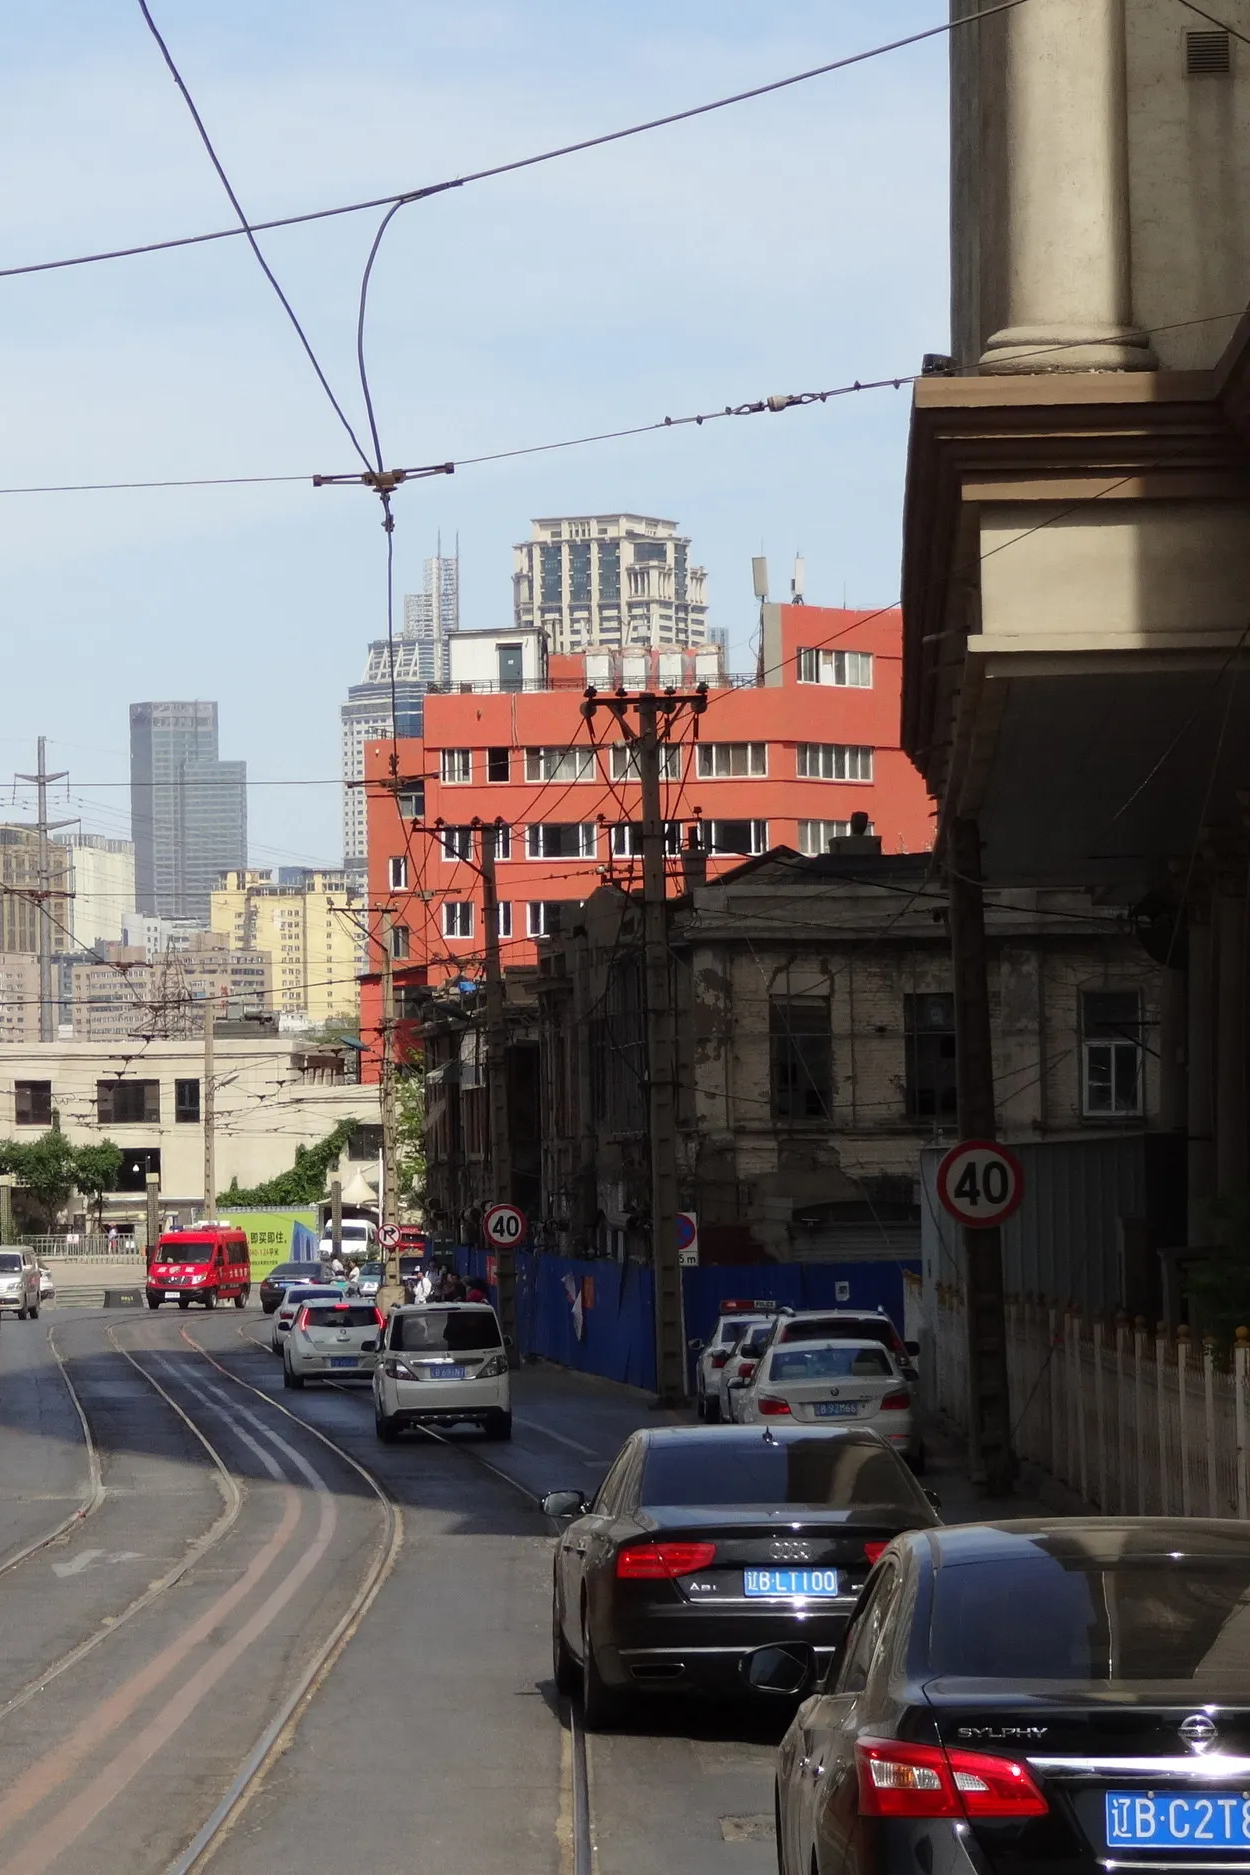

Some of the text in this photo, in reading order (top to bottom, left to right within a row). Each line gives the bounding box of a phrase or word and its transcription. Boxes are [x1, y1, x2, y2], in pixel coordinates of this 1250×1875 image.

[953, 1161, 1009, 1206] 40
[492, 1215, 520, 1237] 40
[958, 1727, 1048, 1739] SYLPHY
